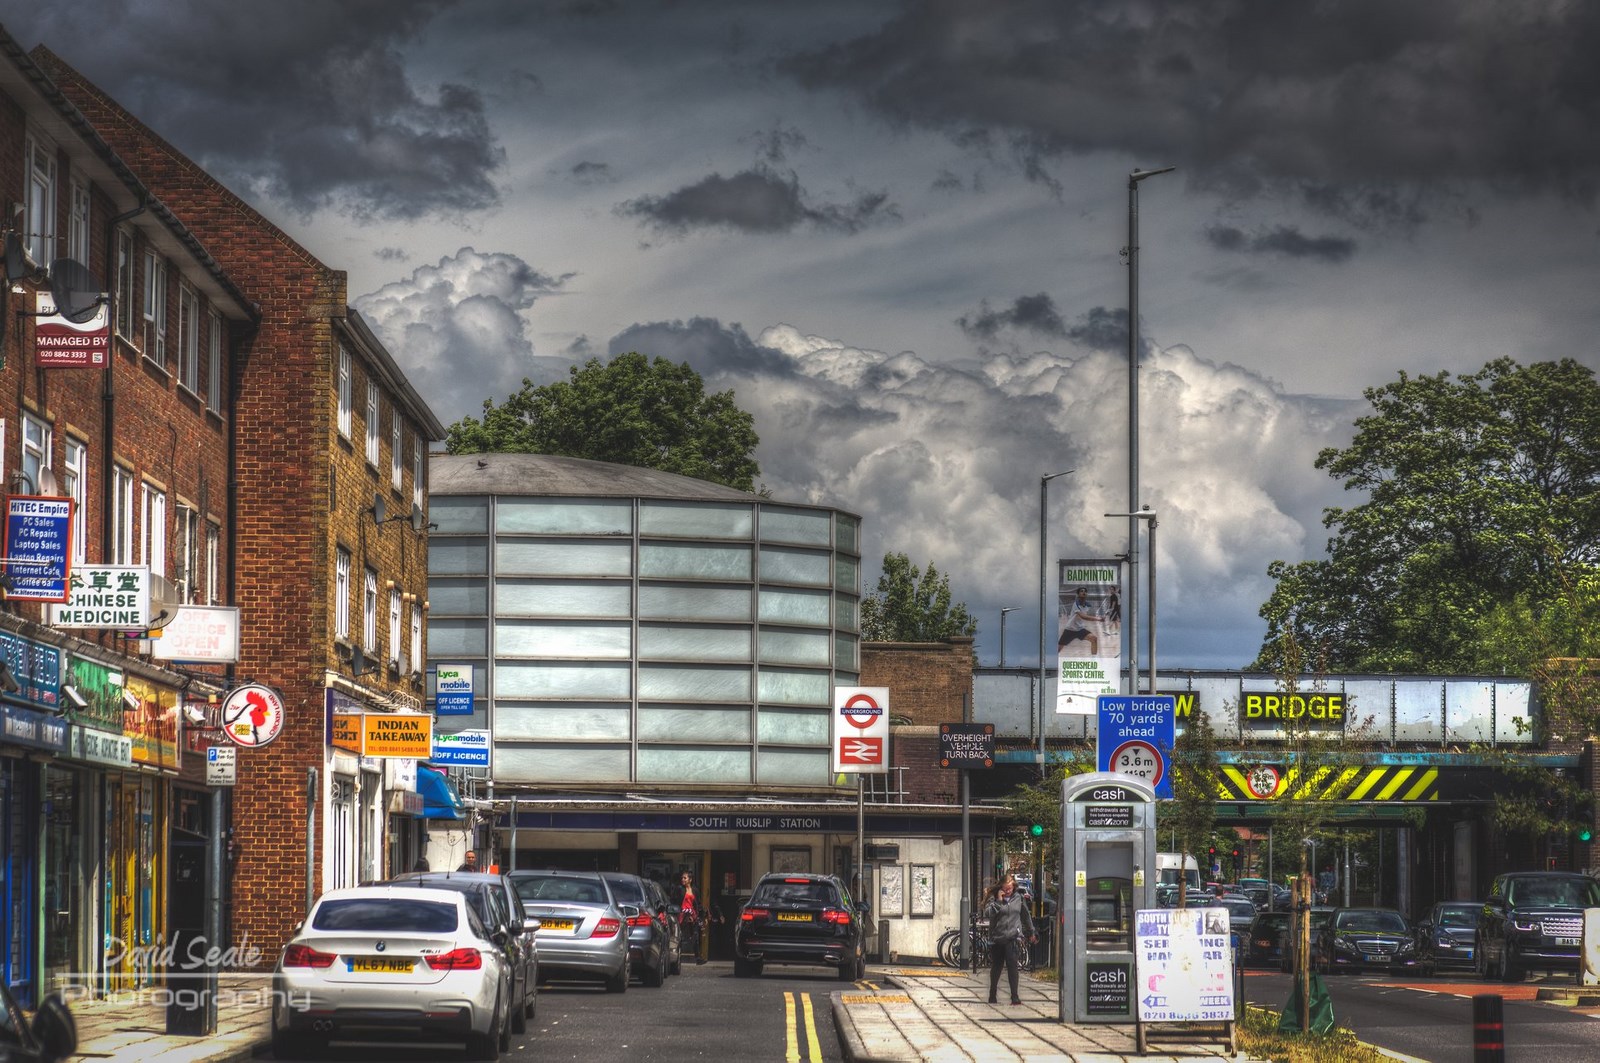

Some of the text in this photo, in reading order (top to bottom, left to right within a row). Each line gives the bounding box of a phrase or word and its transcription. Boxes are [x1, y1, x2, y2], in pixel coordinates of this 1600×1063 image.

[37, 337, 108, 346] MANAGED BY
[38, 504, 68, 515] Empire
[23, 517, 55, 527] PC Sales
[19, 528, 58, 539] PC Repairs
[14, 540, 60, 550] Laptop Sales
[12, 565, 41, 574] Internet
[17, 576, 40, 586] Coffee
[1067, 570, 1114, 582] BADMINTON
[60, 610, 140, 623] MEDICINE
[182, 611, 211, 621] OFF
[171, 635, 219, 649] OPEN
[1062, 661, 1098, 670] QUEENSMEAD
[438, 670, 458, 678] Lyca
[1102, 701, 1171, 713] Low bridge
[1246, 695, 1342, 719] BRIDGE
[1109, 713, 1164, 725] 70 yards
[377, 720, 419, 730] INDIAN
[1118, 726, 1155, 736] ahead
[369, 731, 427, 742] TAKEAWAY
[942, 734, 992, 742] OVERHEIGHT
[210, 750, 215, 759] P
[1093, 788, 1125, 800] cash
[689, 817, 821, 828] SOUTH RUISLIP STATION
[1138, 913, 1166, 923] SOUTH
[356, 960, 386, 970] YL67
[1090, 968, 1126, 982] cash
[1200, 996, 1228, 1005] WEEK
